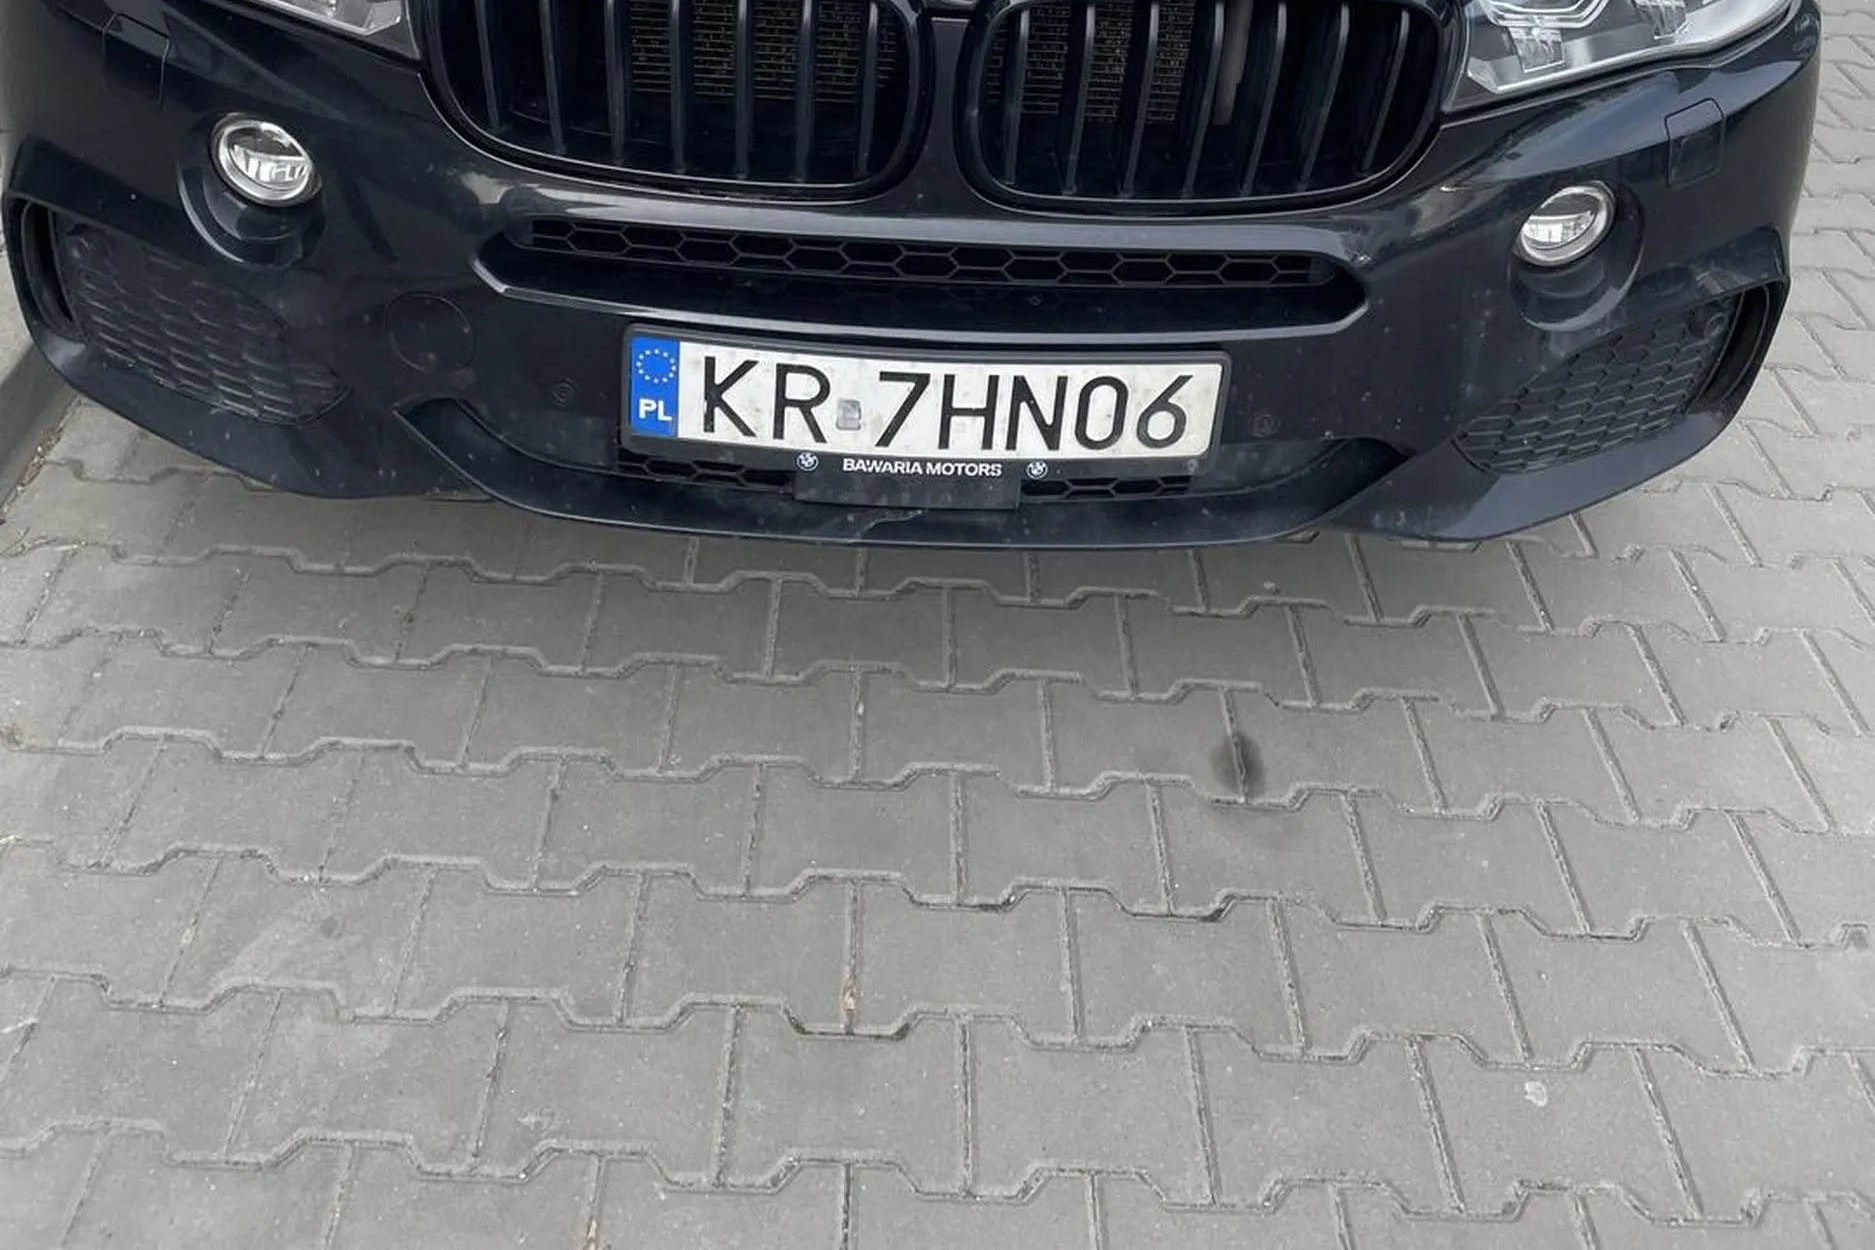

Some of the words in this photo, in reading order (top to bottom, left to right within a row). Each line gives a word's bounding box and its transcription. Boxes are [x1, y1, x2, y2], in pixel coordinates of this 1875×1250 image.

[638, 398, 672, 422] PL
[703, 356, 828, 444] KR
[875, 370, 1194, 451] 7HN06
[842, 457, 920, 476] BAWARIA
[926, 461, 1003, 477] MOTORS
